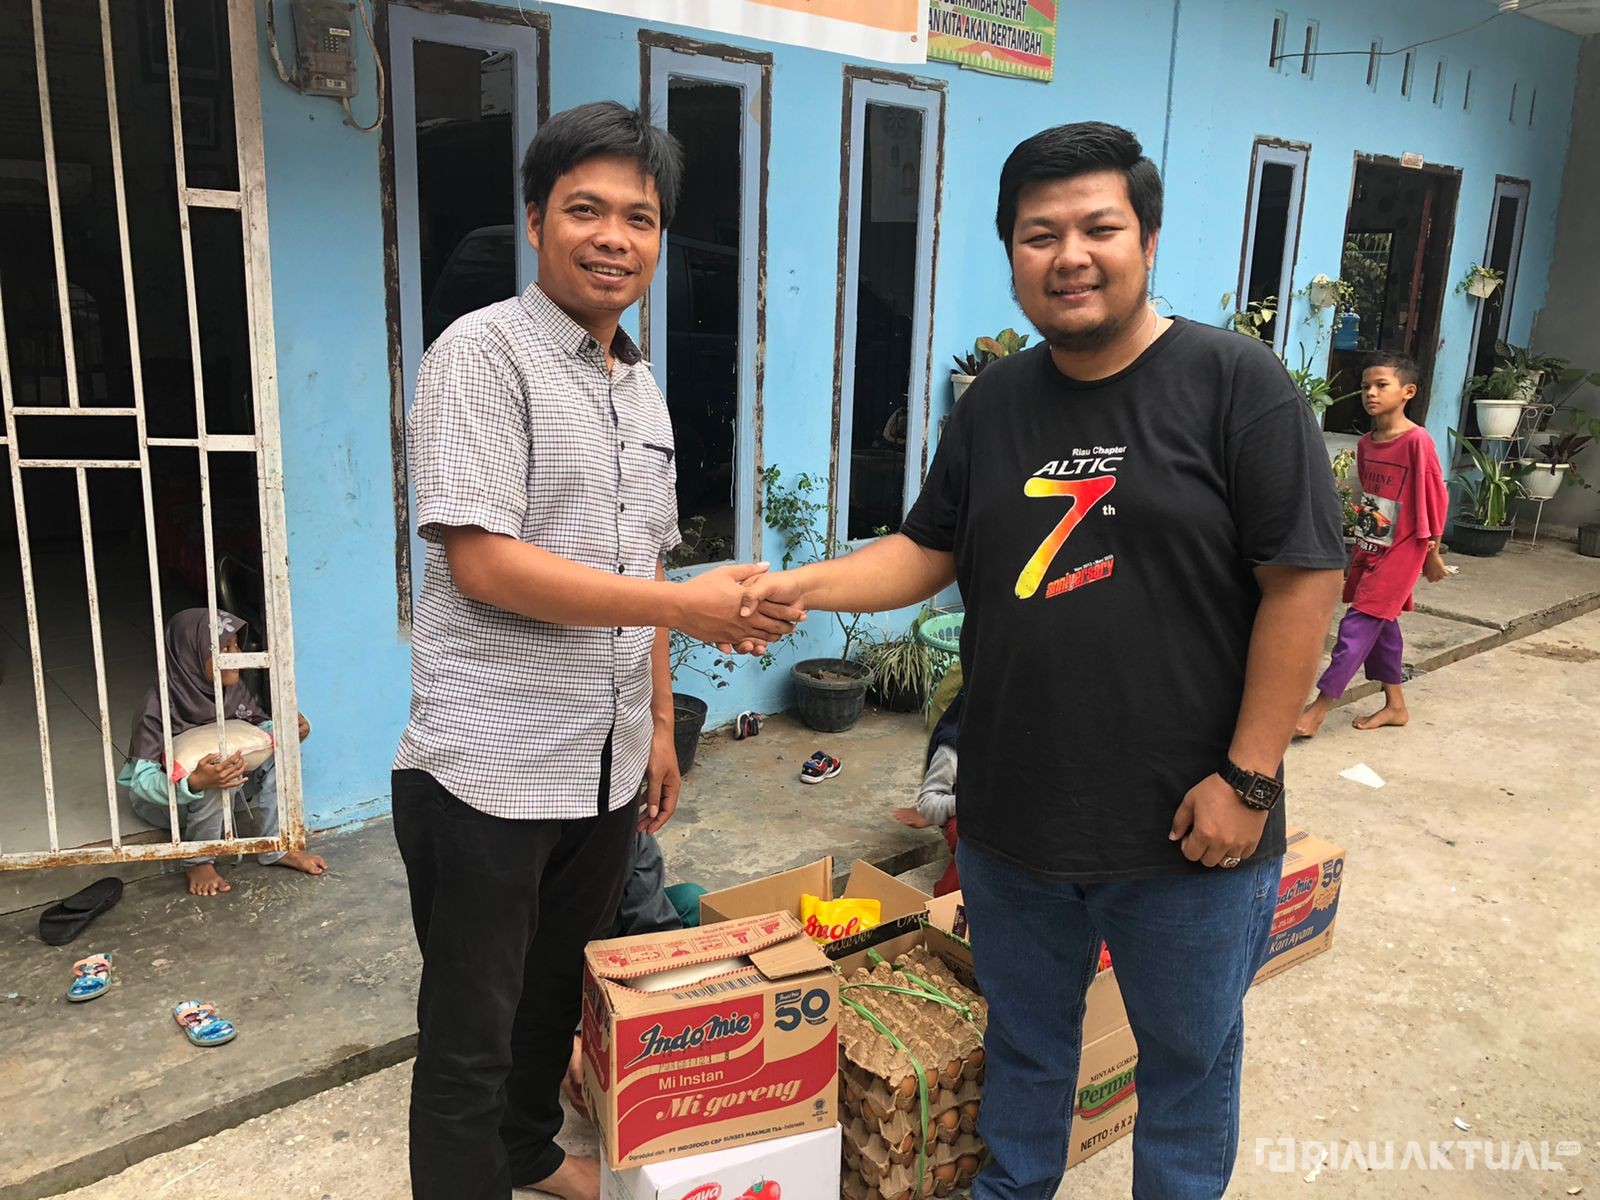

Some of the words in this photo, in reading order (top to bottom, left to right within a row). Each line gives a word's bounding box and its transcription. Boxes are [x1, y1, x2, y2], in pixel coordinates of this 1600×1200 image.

[999, 0, 1027, 22] SEHAT
[942, 11, 963, 37] KITA
[963, 16, 991, 42] AKAN
[991, 23, 1042, 55] BERTAMBAH
[1072, 448, 1091, 456] Riau
[1092, 446, 1127, 455] Chapter
[1033, 457, 1124, 476] ALTIC
[1045, 559, 1114, 599] anniversary
[1321, 858, 1344, 888] 50
[774, 988, 830, 1031] 50
[658, 1076, 676, 1091] Mi
[679, 1069, 725, 1088] Instan
[1090, 1065, 1116, 1082] MINYAK
[655, 1094, 705, 1120] Mi
[702, 1079, 803, 1118] goreng
[723, 1133, 745, 1142] SUKSES
[745, 1127, 771, 1137] MAKMUR
[1080, 1129, 1108, 1153] NETTO
[1114, 1122, 1120, 1133] 6
